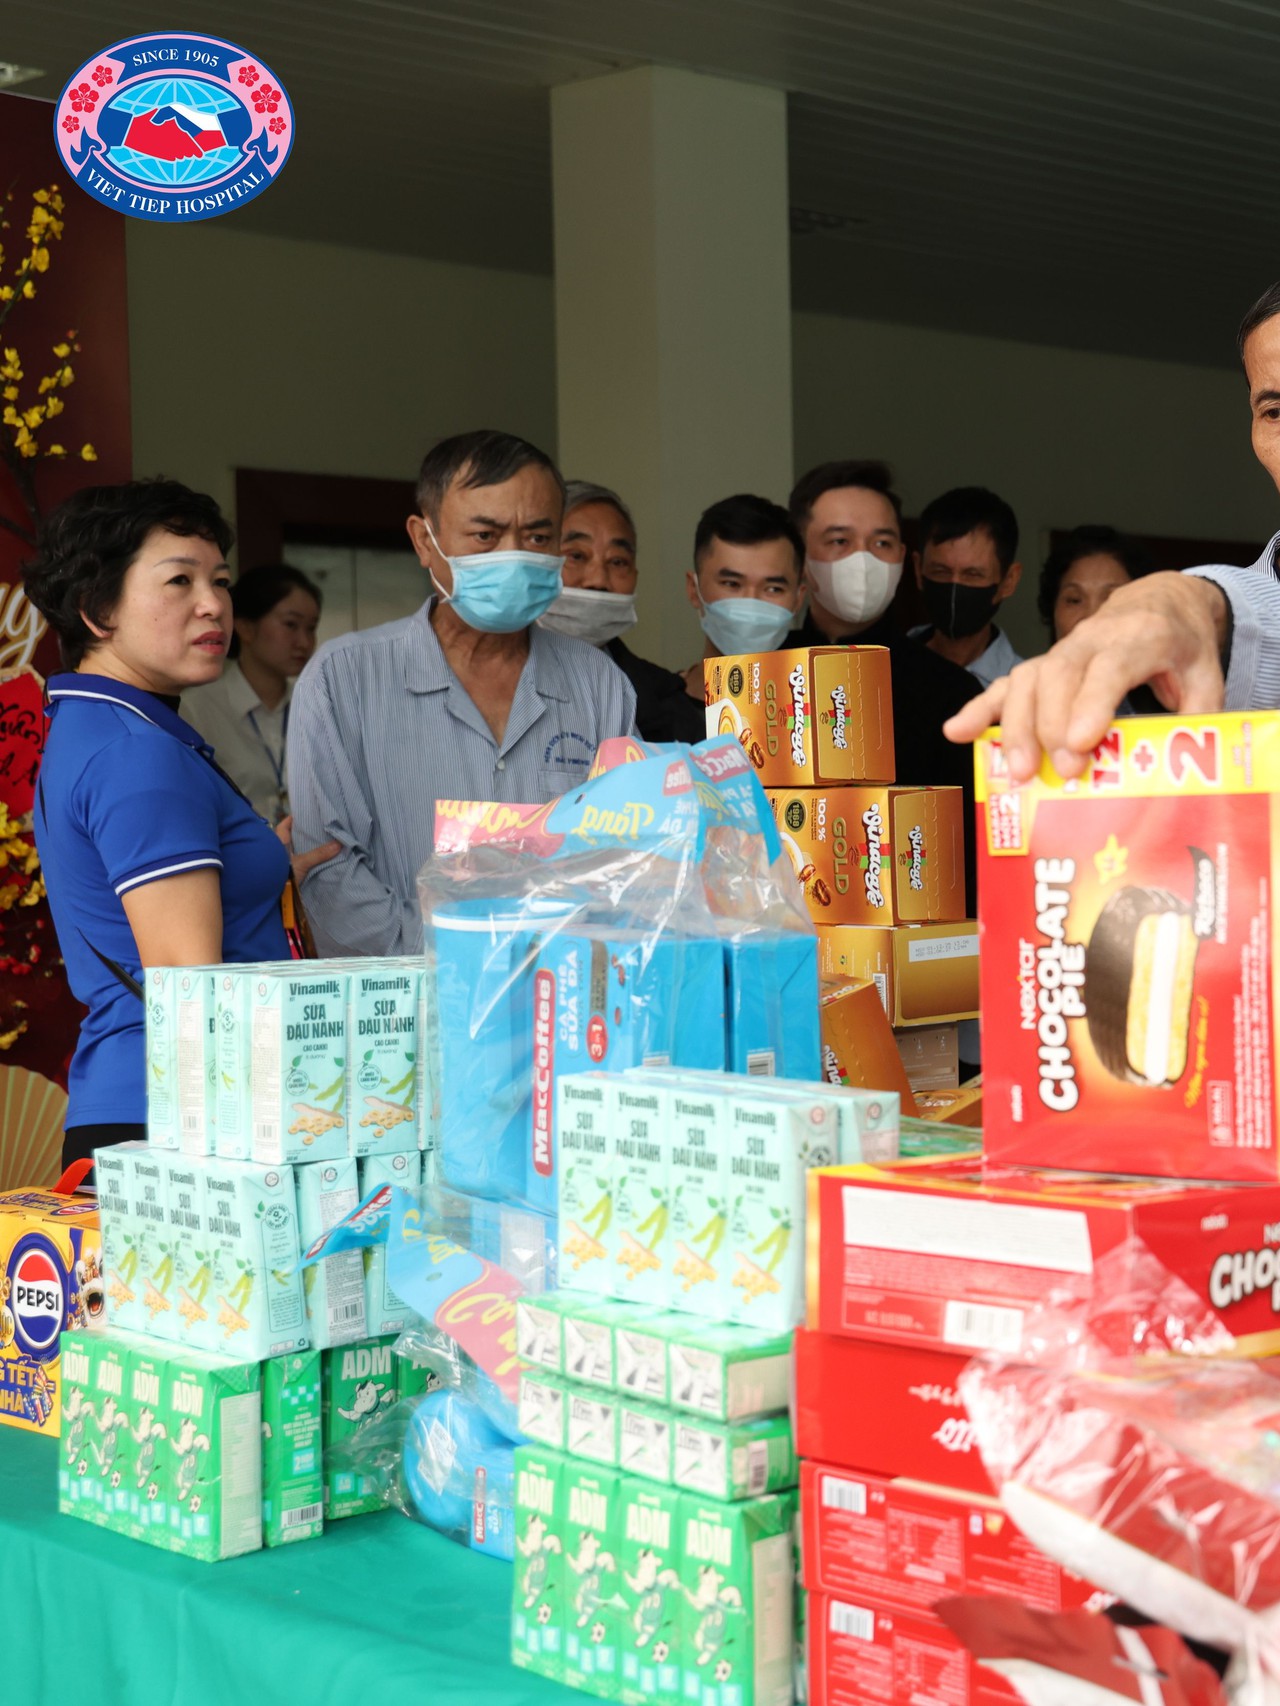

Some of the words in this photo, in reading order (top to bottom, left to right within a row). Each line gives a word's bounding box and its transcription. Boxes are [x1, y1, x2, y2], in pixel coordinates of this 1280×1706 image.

[752, 662, 760, 687] 100
[765, 679, 780, 757] GOLD
[1091, 728, 1123, 792] 12
[1167, 727, 1220, 786] 2
[818, 797, 826, 822] 100
[832, 817, 849, 895] GOLD
[289, 980, 340, 996] Vinamilk
[361, 976, 410, 991] Vinamilk
[1034, 856, 1081, 1112] CHOCOLATE
[1059, 943, 1086, 1018] PIE
[535, 977, 551, 1165] MacCoffee
[17, 1285, 59, 1312] PEPSI
[7, 1359, 36, 1388] TẾT
[341, 1346, 392, 1380] ADM
[172, 1380, 203, 1417] ADM
